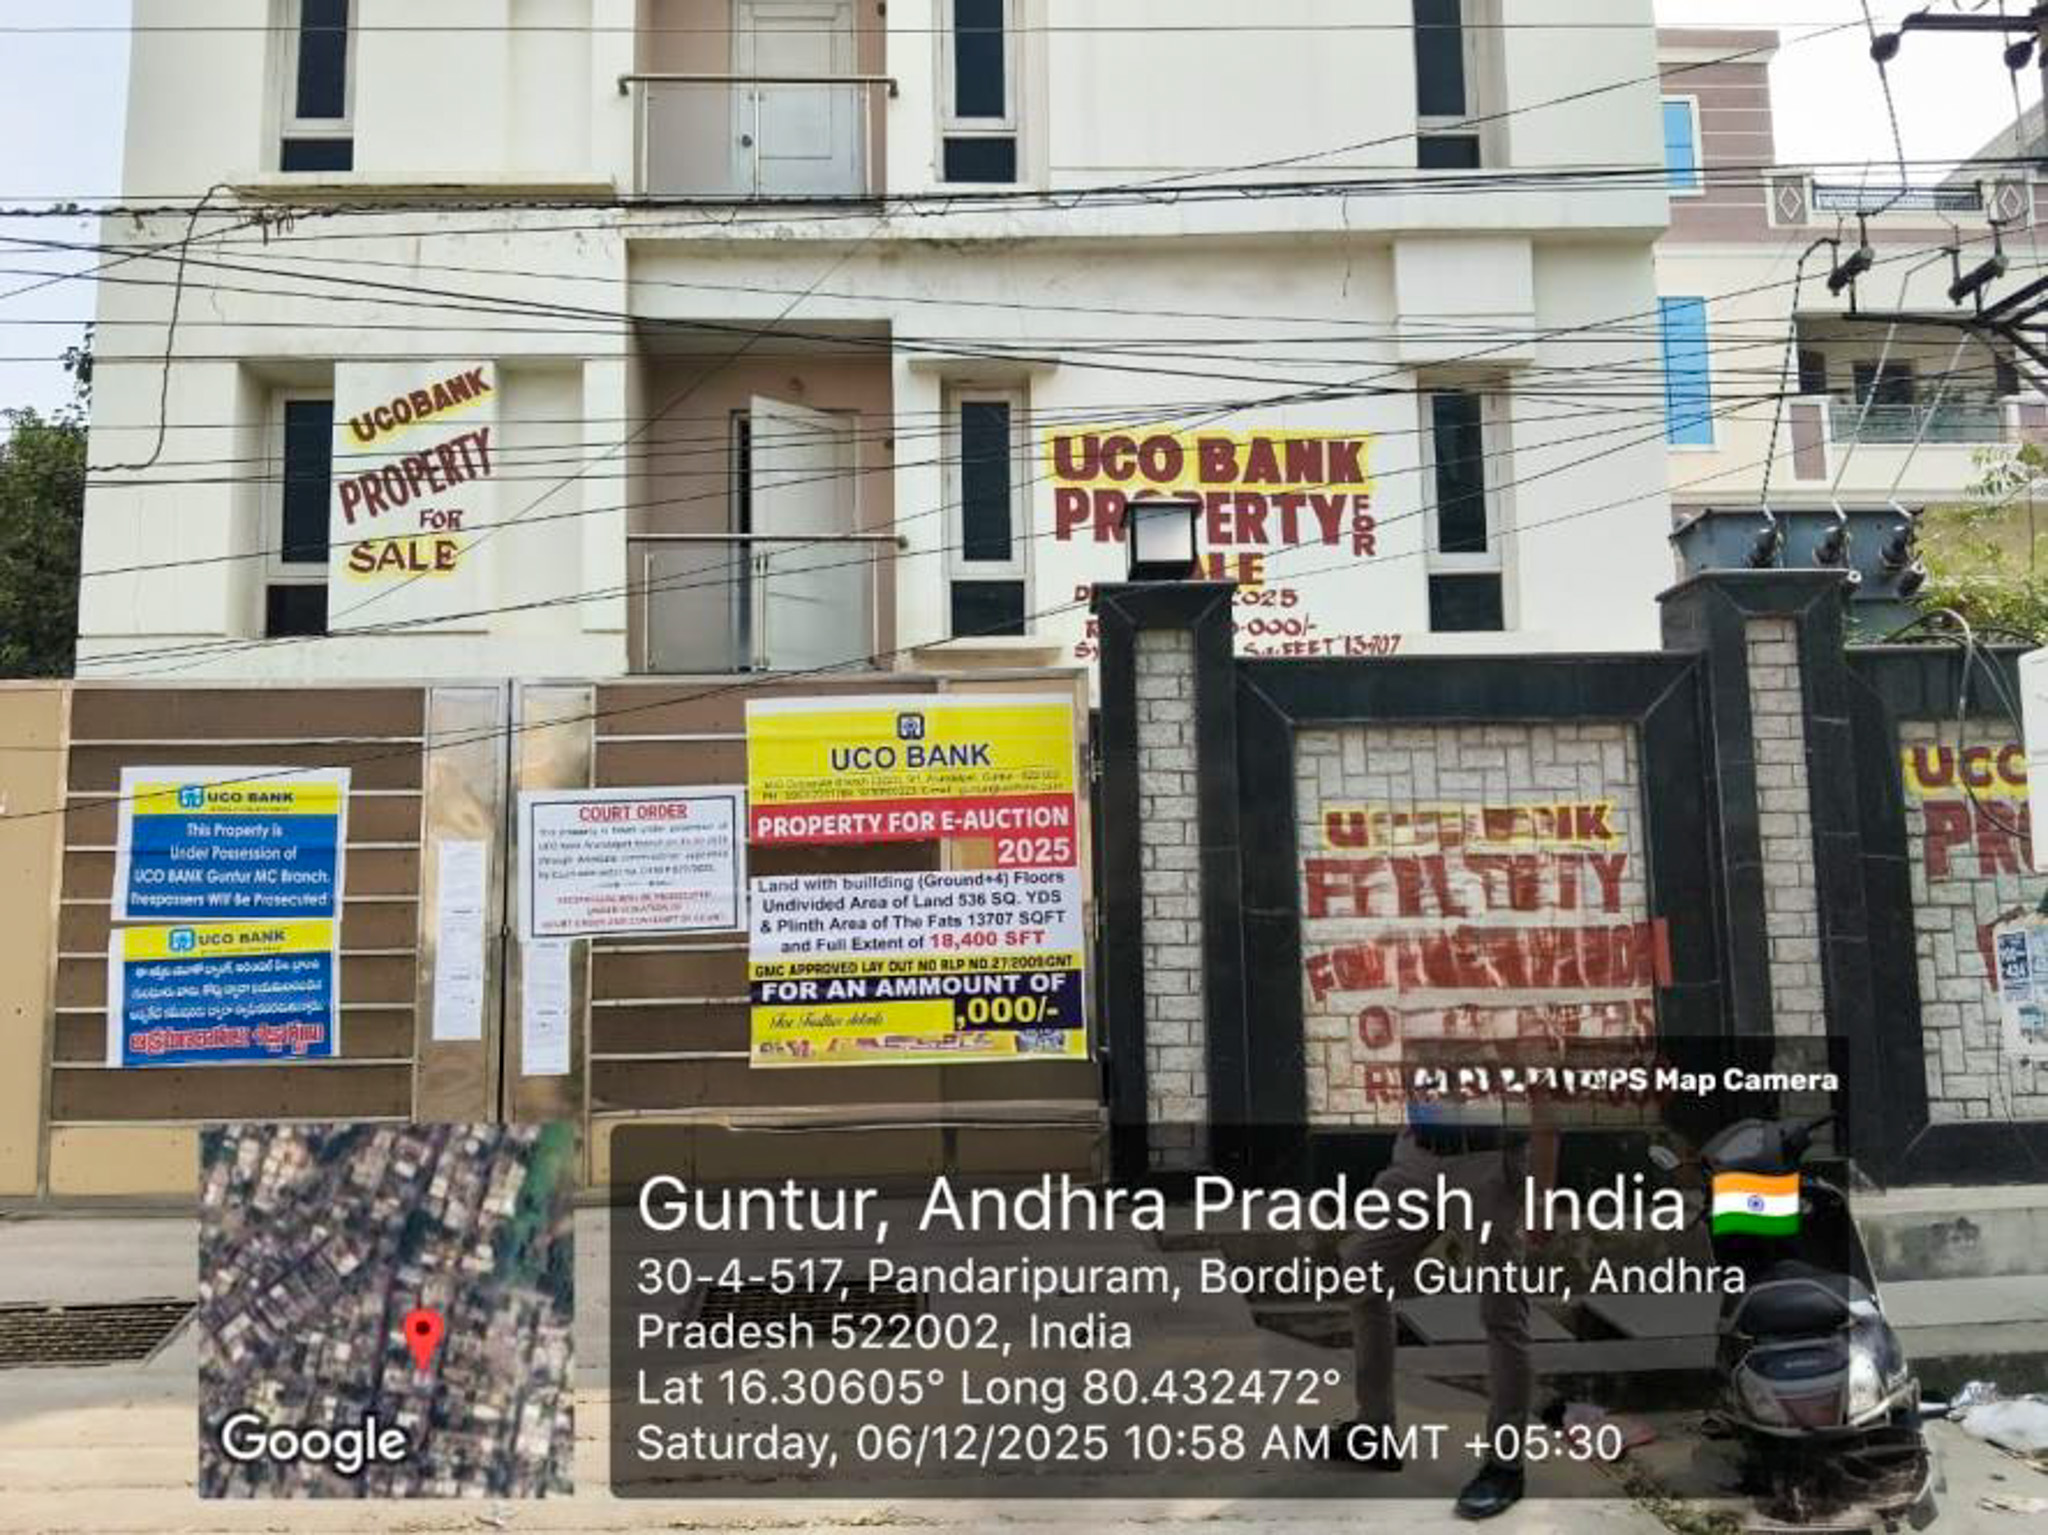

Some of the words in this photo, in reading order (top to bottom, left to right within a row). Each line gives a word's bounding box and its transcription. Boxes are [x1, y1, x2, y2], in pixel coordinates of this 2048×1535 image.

[1053, 435, 1183, 482] UCO
[1198, 437, 1365, 484] BANK
[339, 427, 490, 524] PROPERTY
[420, 508, 464, 530] FOR
[1054, 487, 1348, 545] PRERTY
[1353, 494, 1377, 556] FOR
[349, 540, 459, 573] SALE
[831, 747, 895, 771] UCO
[906, 744, 991, 769] BANK
[207, 791, 242, 804] UCO
[249, 791, 295, 804] BANK
[579, 806, 631, 822] COURT
[637, 804, 688, 819] ORDER
[757, 813, 883, 838] PROPERTY
[888, 810, 935, 834] FOR
[941, 807, 1069, 831] E-AUCTION
[186, 822, 211, 837] This
[214, 823, 268, 840] Property
[272, 822, 283, 836] is
[170, 845, 209, 861] Under
[211, 846, 281, 861] Possession
[283, 845, 298, 860] of
[998, 837, 1070, 864] 2025
[134, 869, 165, 883] UCO
[168, 868, 204, 884] BANK
[207, 869, 250, 884] Guntur
[253, 868, 278, 884] MC
[758, 878, 799, 893] Land
[804, 877, 838, 891] with
[1013, 871, 1065, 885] Floors
[762, 897, 845, 913] Undivided
[850, 896, 887, 910] Area
[892, 895, 910, 909] of
[914, 894, 953, 909] Land
[959, 893, 986, 907] 536
[1026, 889, 1062, 904] YDS
[760, 920, 771, 934] &
[777, 918, 823, 933] Plinth
[829, 917, 867, 931] Area
[871, 915, 888, 929] of
[892, 914, 922, 929] The
[928, 914, 962, 928] Fats
[968, 912, 1013, 927] 13707
[1019, 910, 1066, 925] SQFT
[199, 933, 233, 946] UCO
[239, 929, 286, 944] BANK
[781, 938, 811, 953] and
[816, 937, 846, 952] Full
[852, 936, 903, 951] Extent
[908, 935, 924, 949] of
[930, 931, 997, 950] 18,400
[1005, 929, 1045, 946] SFT
[755, 964, 787, 978] GMC
[789, 961, 858, 977] APPROVED
[862, 959, 886, 974] LAY
[889, 958, 912, 974] OUT
[762, 981, 818, 1002] FOR
[827, 979, 866, 1000] AN
[876, 974, 1020, 998] AMMOUNT
[1030, 972, 1067, 993] OF
